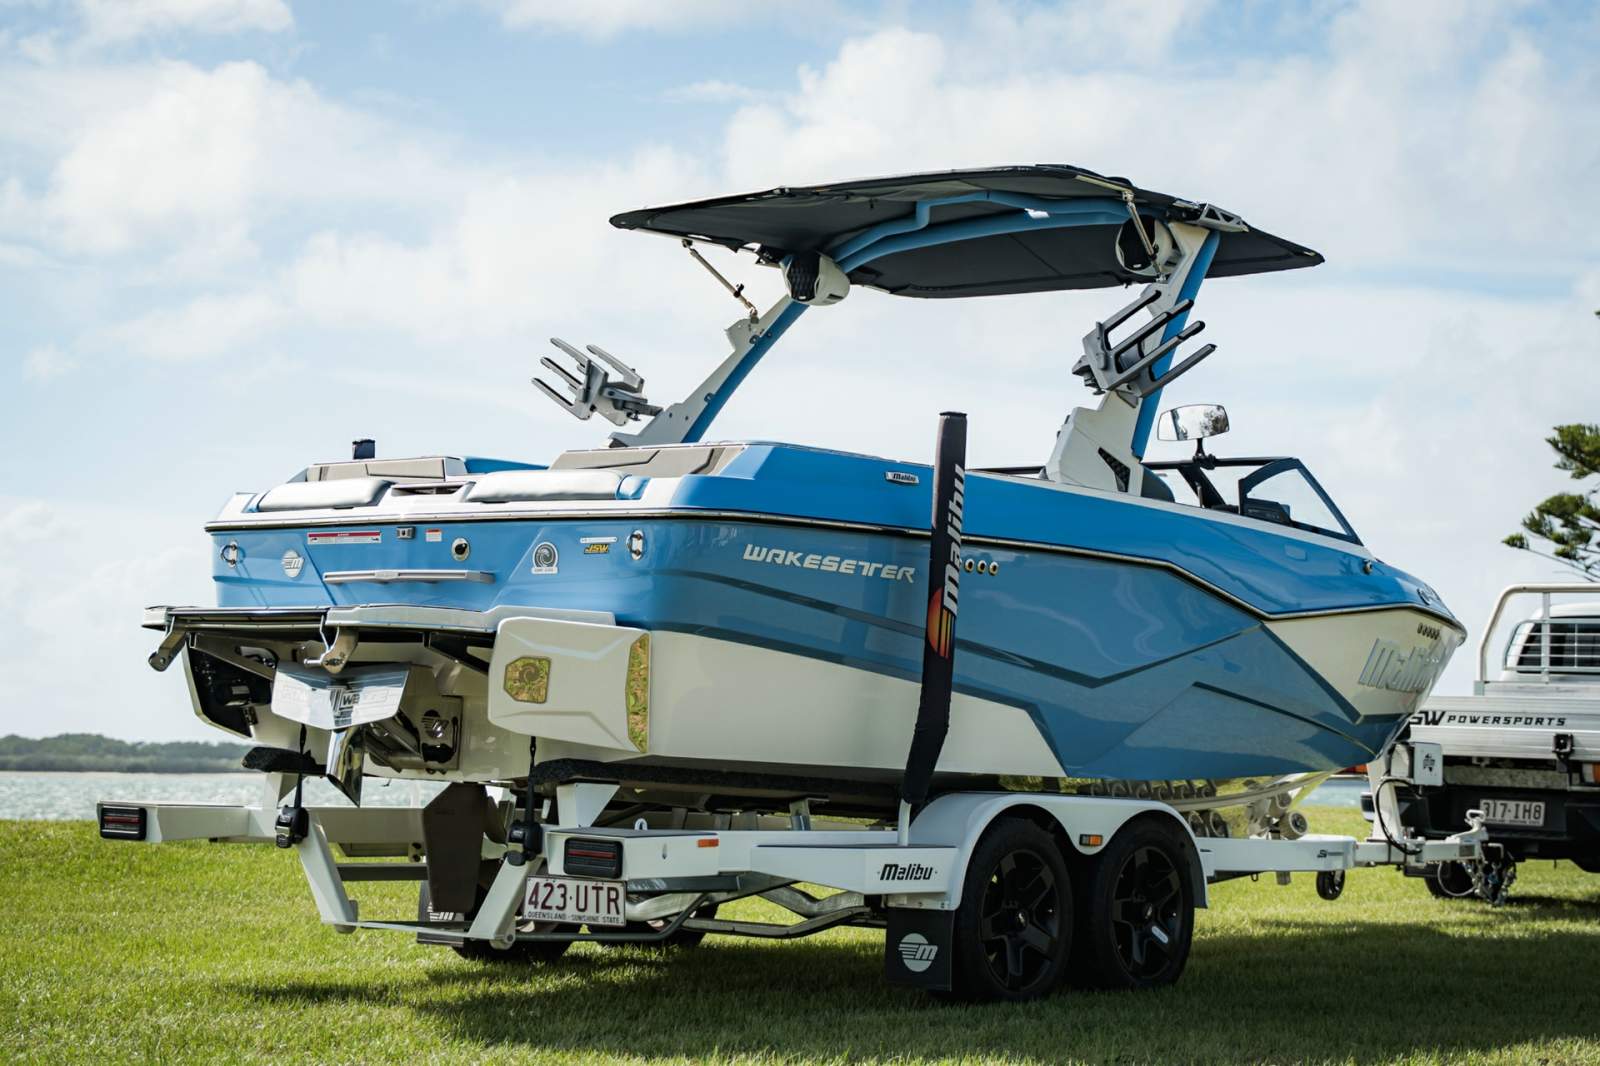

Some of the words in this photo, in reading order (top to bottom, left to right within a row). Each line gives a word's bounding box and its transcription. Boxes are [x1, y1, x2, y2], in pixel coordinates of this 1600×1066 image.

[743, 543, 916, 583] WAKESETTER
[1447, 714, 1567, 726] POWERSPORTS
[880, 863, 934, 881] Malibu
[528, 911, 567, 921] QUEENSLAND
[602, 915, 620, 925] STATE
